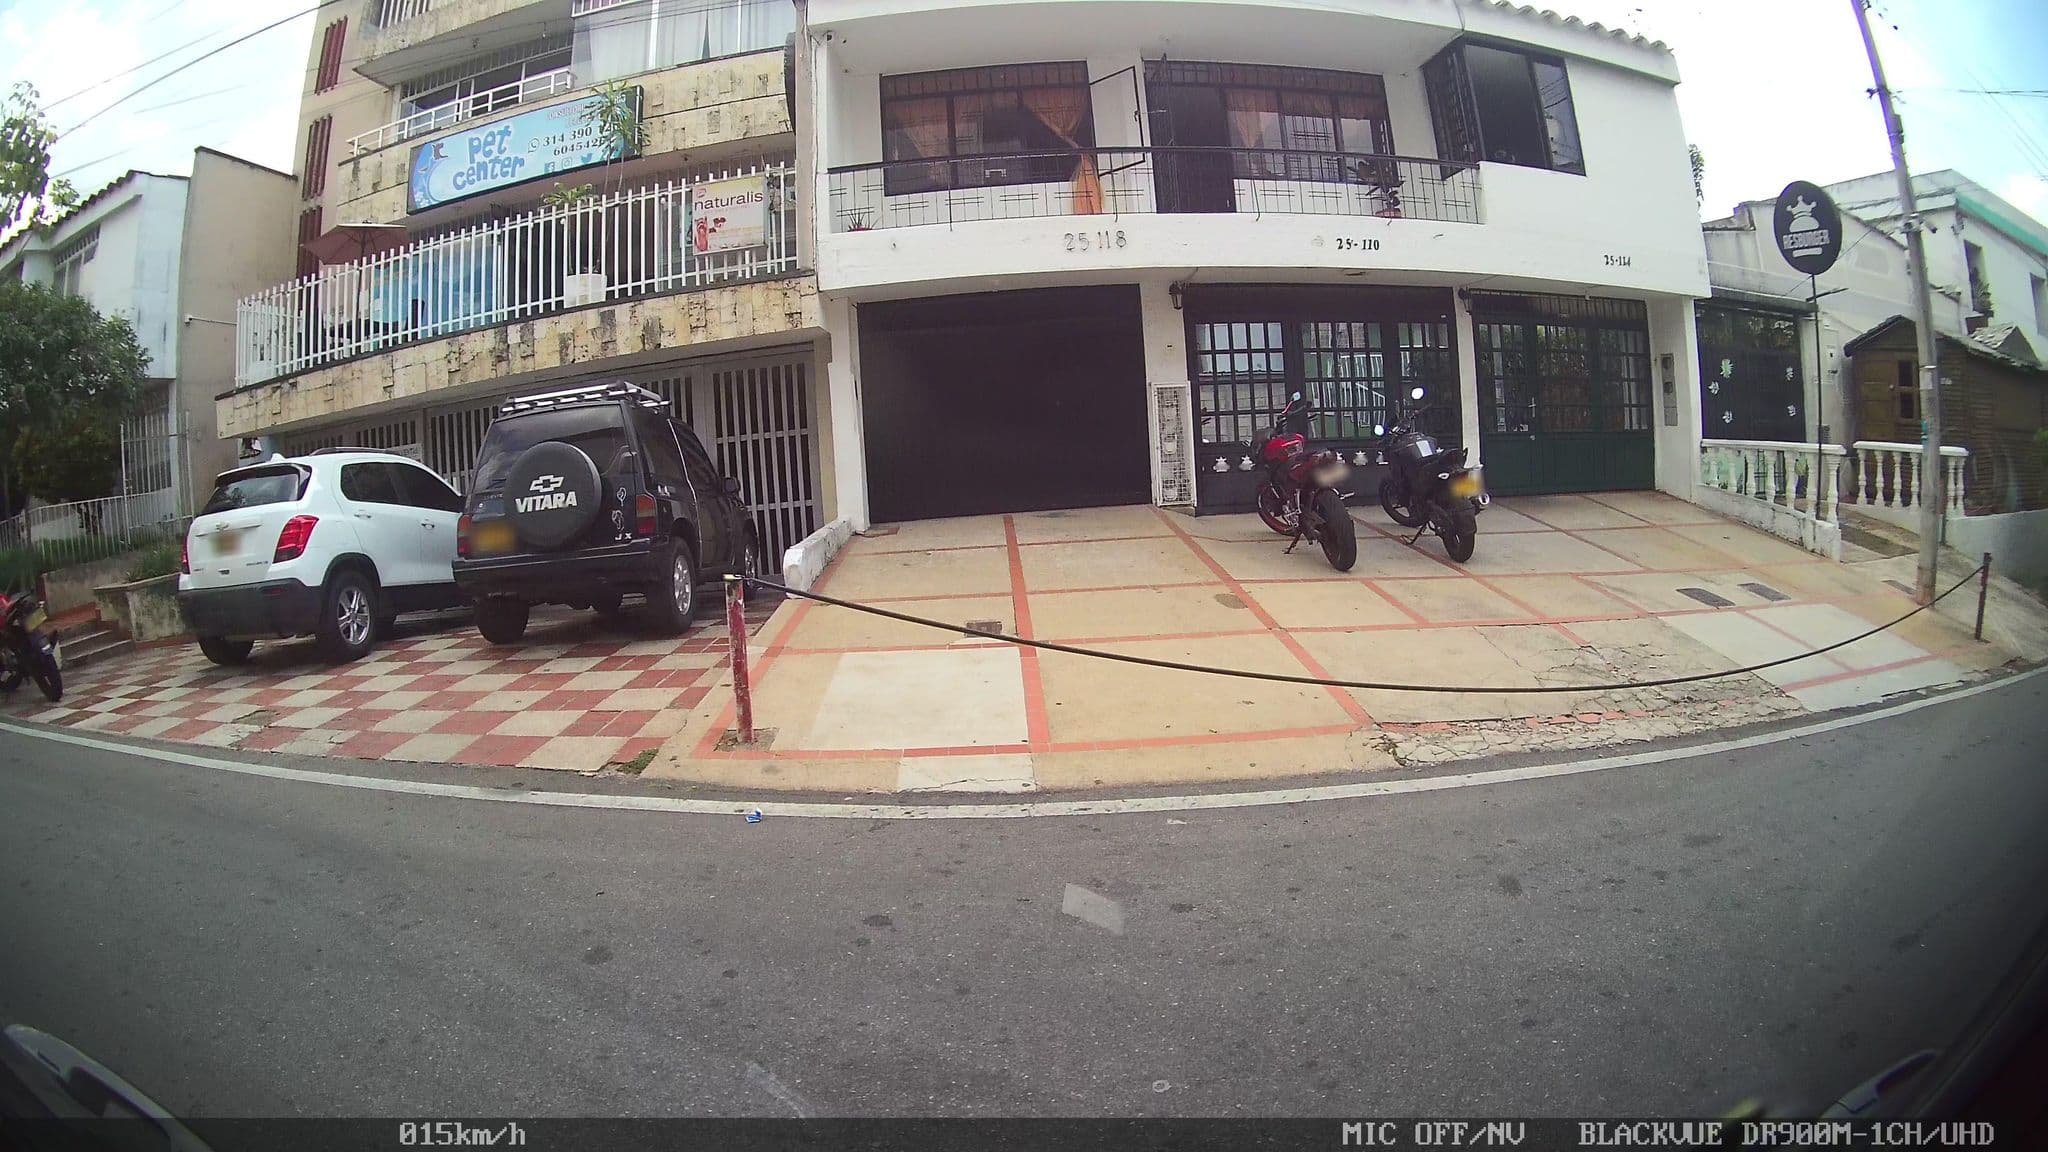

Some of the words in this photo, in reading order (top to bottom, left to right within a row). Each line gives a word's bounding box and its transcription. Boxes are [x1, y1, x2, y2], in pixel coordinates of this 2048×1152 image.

[468, 125, 512, 164] pet
[543, 132, 566, 147] 314
[571, 126, 593, 140] 390
[453, 156, 525, 190] center
[694, 191, 763, 211] naturalis
[515, 491, 578, 513] VITARA
